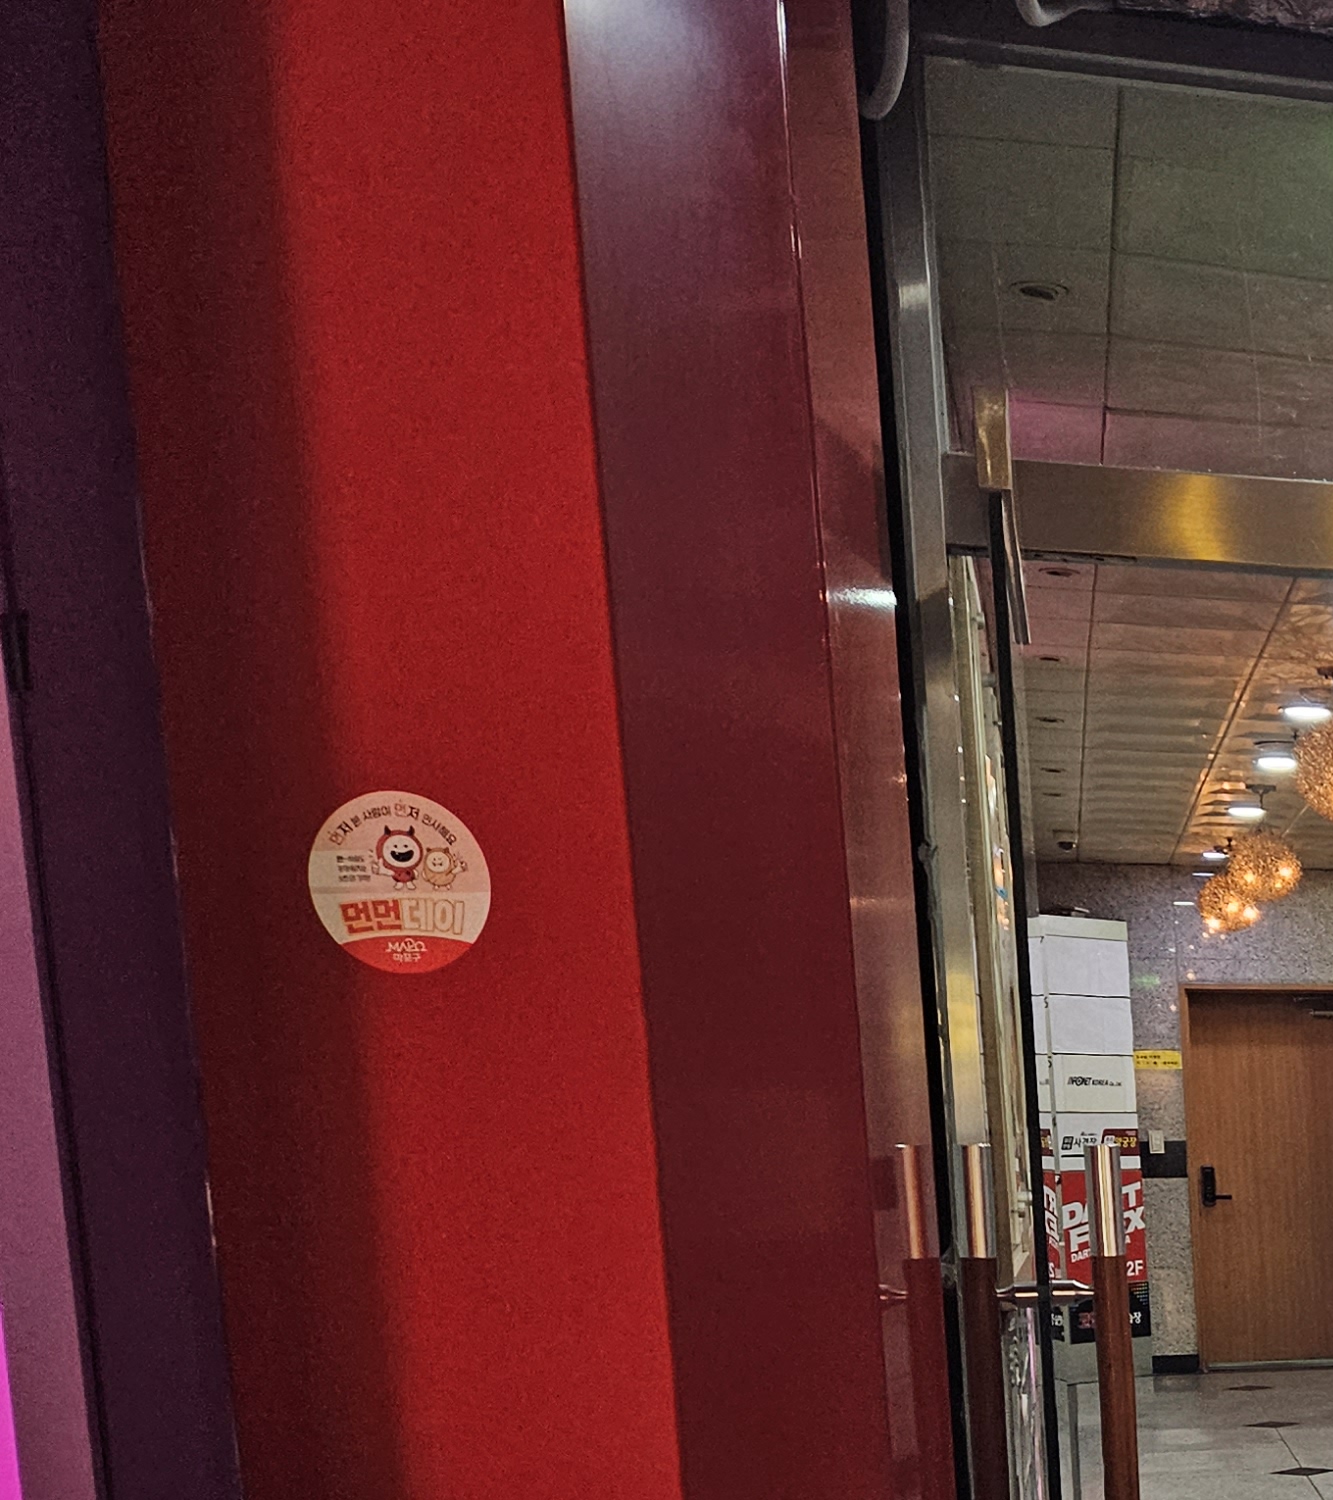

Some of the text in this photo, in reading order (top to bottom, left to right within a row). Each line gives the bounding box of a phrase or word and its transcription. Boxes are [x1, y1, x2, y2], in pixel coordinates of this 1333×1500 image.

[338, 898, 466, 936] 먼먼데이
[385, 937, 428, 952] MAPO
[1126, 1260, 1144, 1276] 2F
